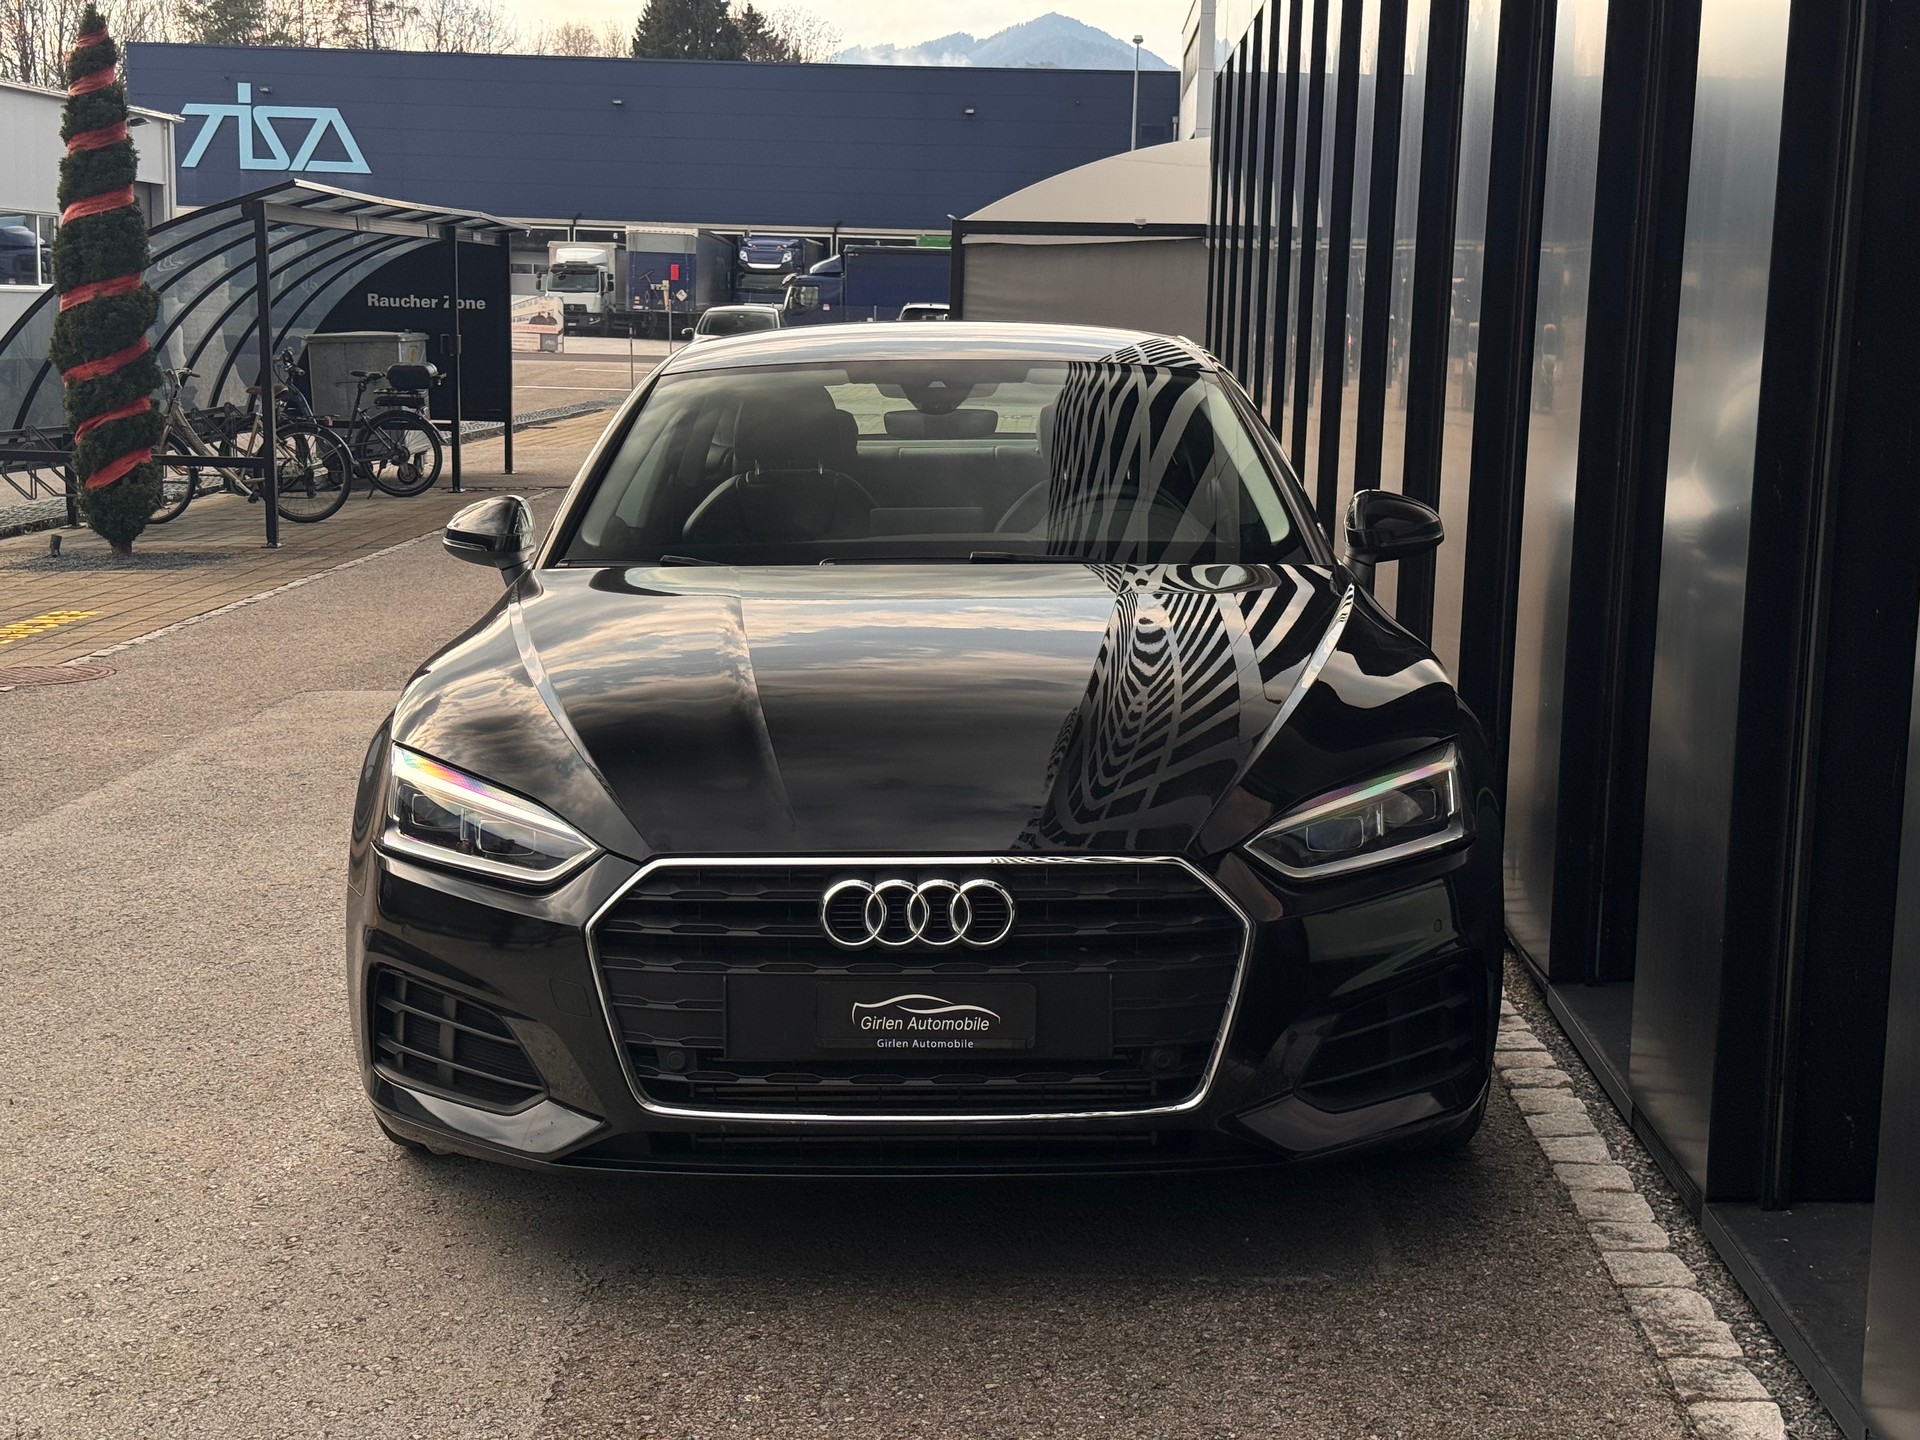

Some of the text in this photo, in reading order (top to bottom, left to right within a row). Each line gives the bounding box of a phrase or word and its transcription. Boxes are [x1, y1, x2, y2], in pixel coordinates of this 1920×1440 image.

[525, 230, 531, 238] 7
[367, 293, 438, 308] Raucher
[861, 1016, 990, 1031] Girlen Automobile
[876, 1039, 974, 1048] Girlen Automobile
